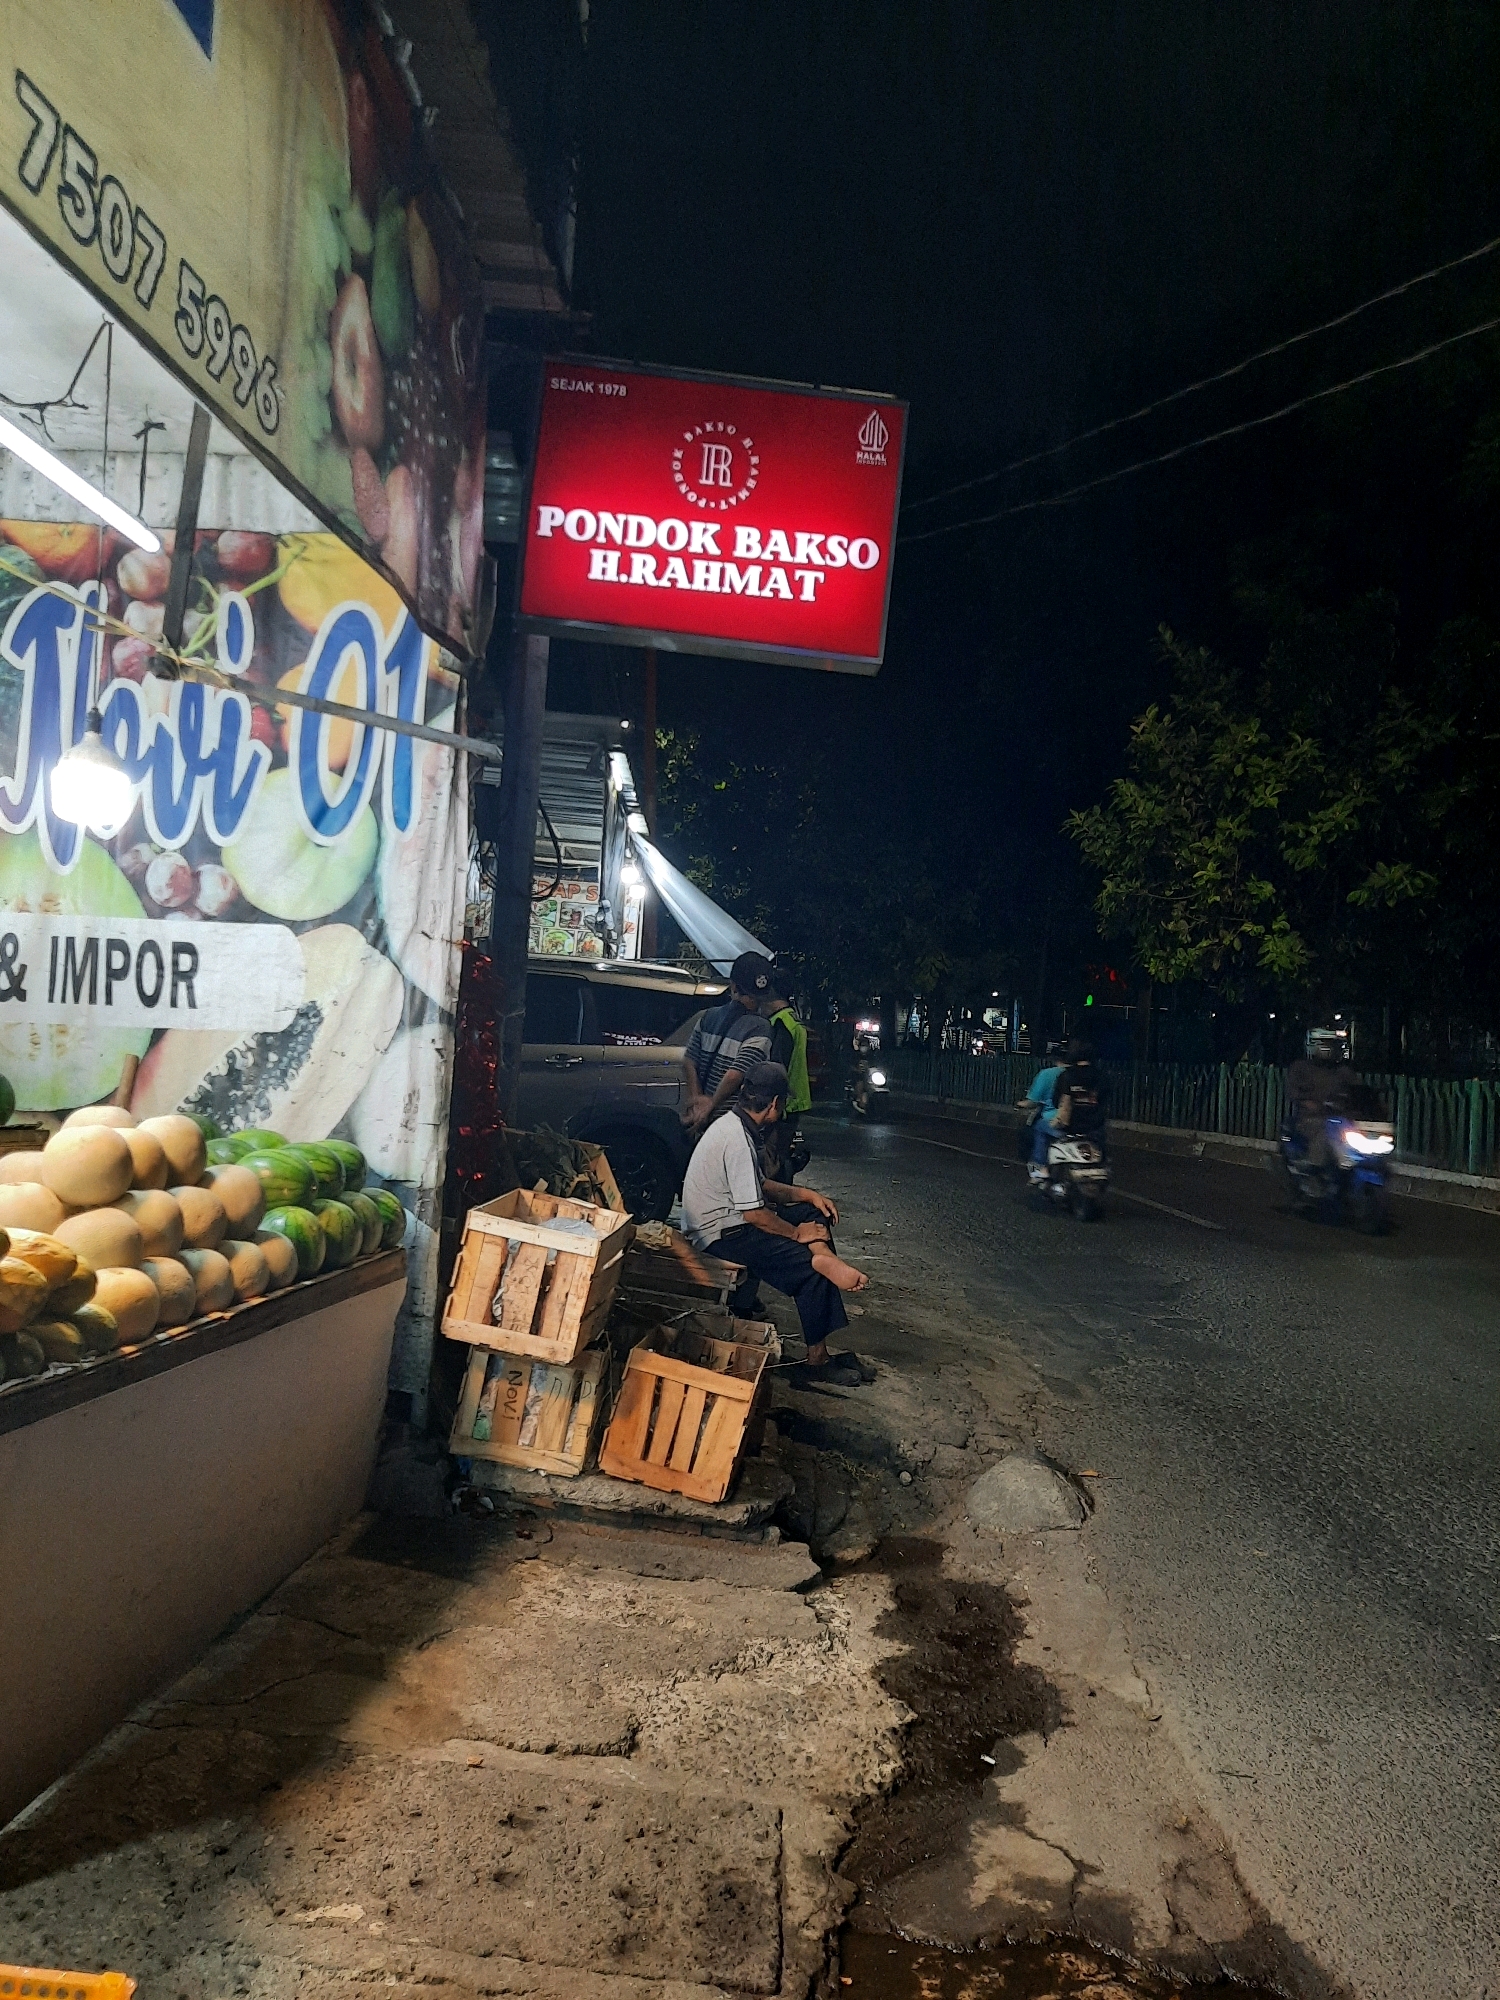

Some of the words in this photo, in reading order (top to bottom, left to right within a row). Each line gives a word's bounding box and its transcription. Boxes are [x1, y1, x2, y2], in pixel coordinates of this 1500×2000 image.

[15, 69, 167, 311] 7507
[174, 257, 281, 436] 5996
[550, 377, 595, 394] SEJAK
[598, 382, 627, 397] 1978
[683, 421, 737, 443] BAKSO
[856, 451, 887, 462] HALAL
[671, 447, 708, 509] PONDOK
[537, 506, 721, 556] PONDOK
[732, 526, 880, 570] BAKSO
[587, 548, 825, 602] H.RAHMAT
[47, 935, 200, 1010] IMPOR
